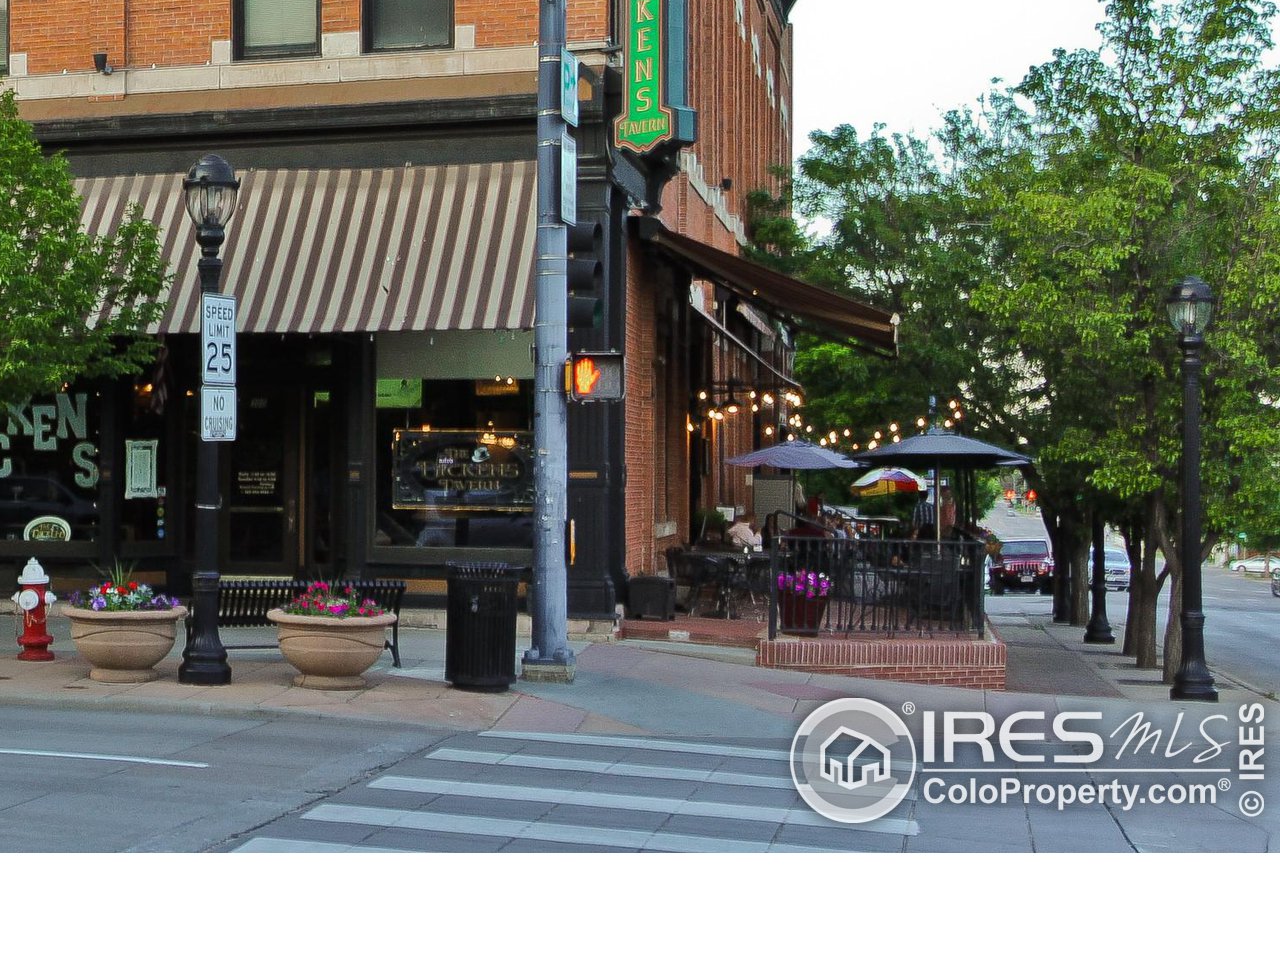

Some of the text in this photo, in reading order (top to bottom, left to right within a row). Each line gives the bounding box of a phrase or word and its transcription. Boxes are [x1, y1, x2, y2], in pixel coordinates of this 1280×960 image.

[619, 119, 666, 137] TAVERN
[205, 305, 233, 321] SPEED
[208, 323, 230, 338] LIMIT
[206, 342, 232, 373] 25
[213, 396, 225, 411] NO
[204, 417, 233, 431] CRUISING
